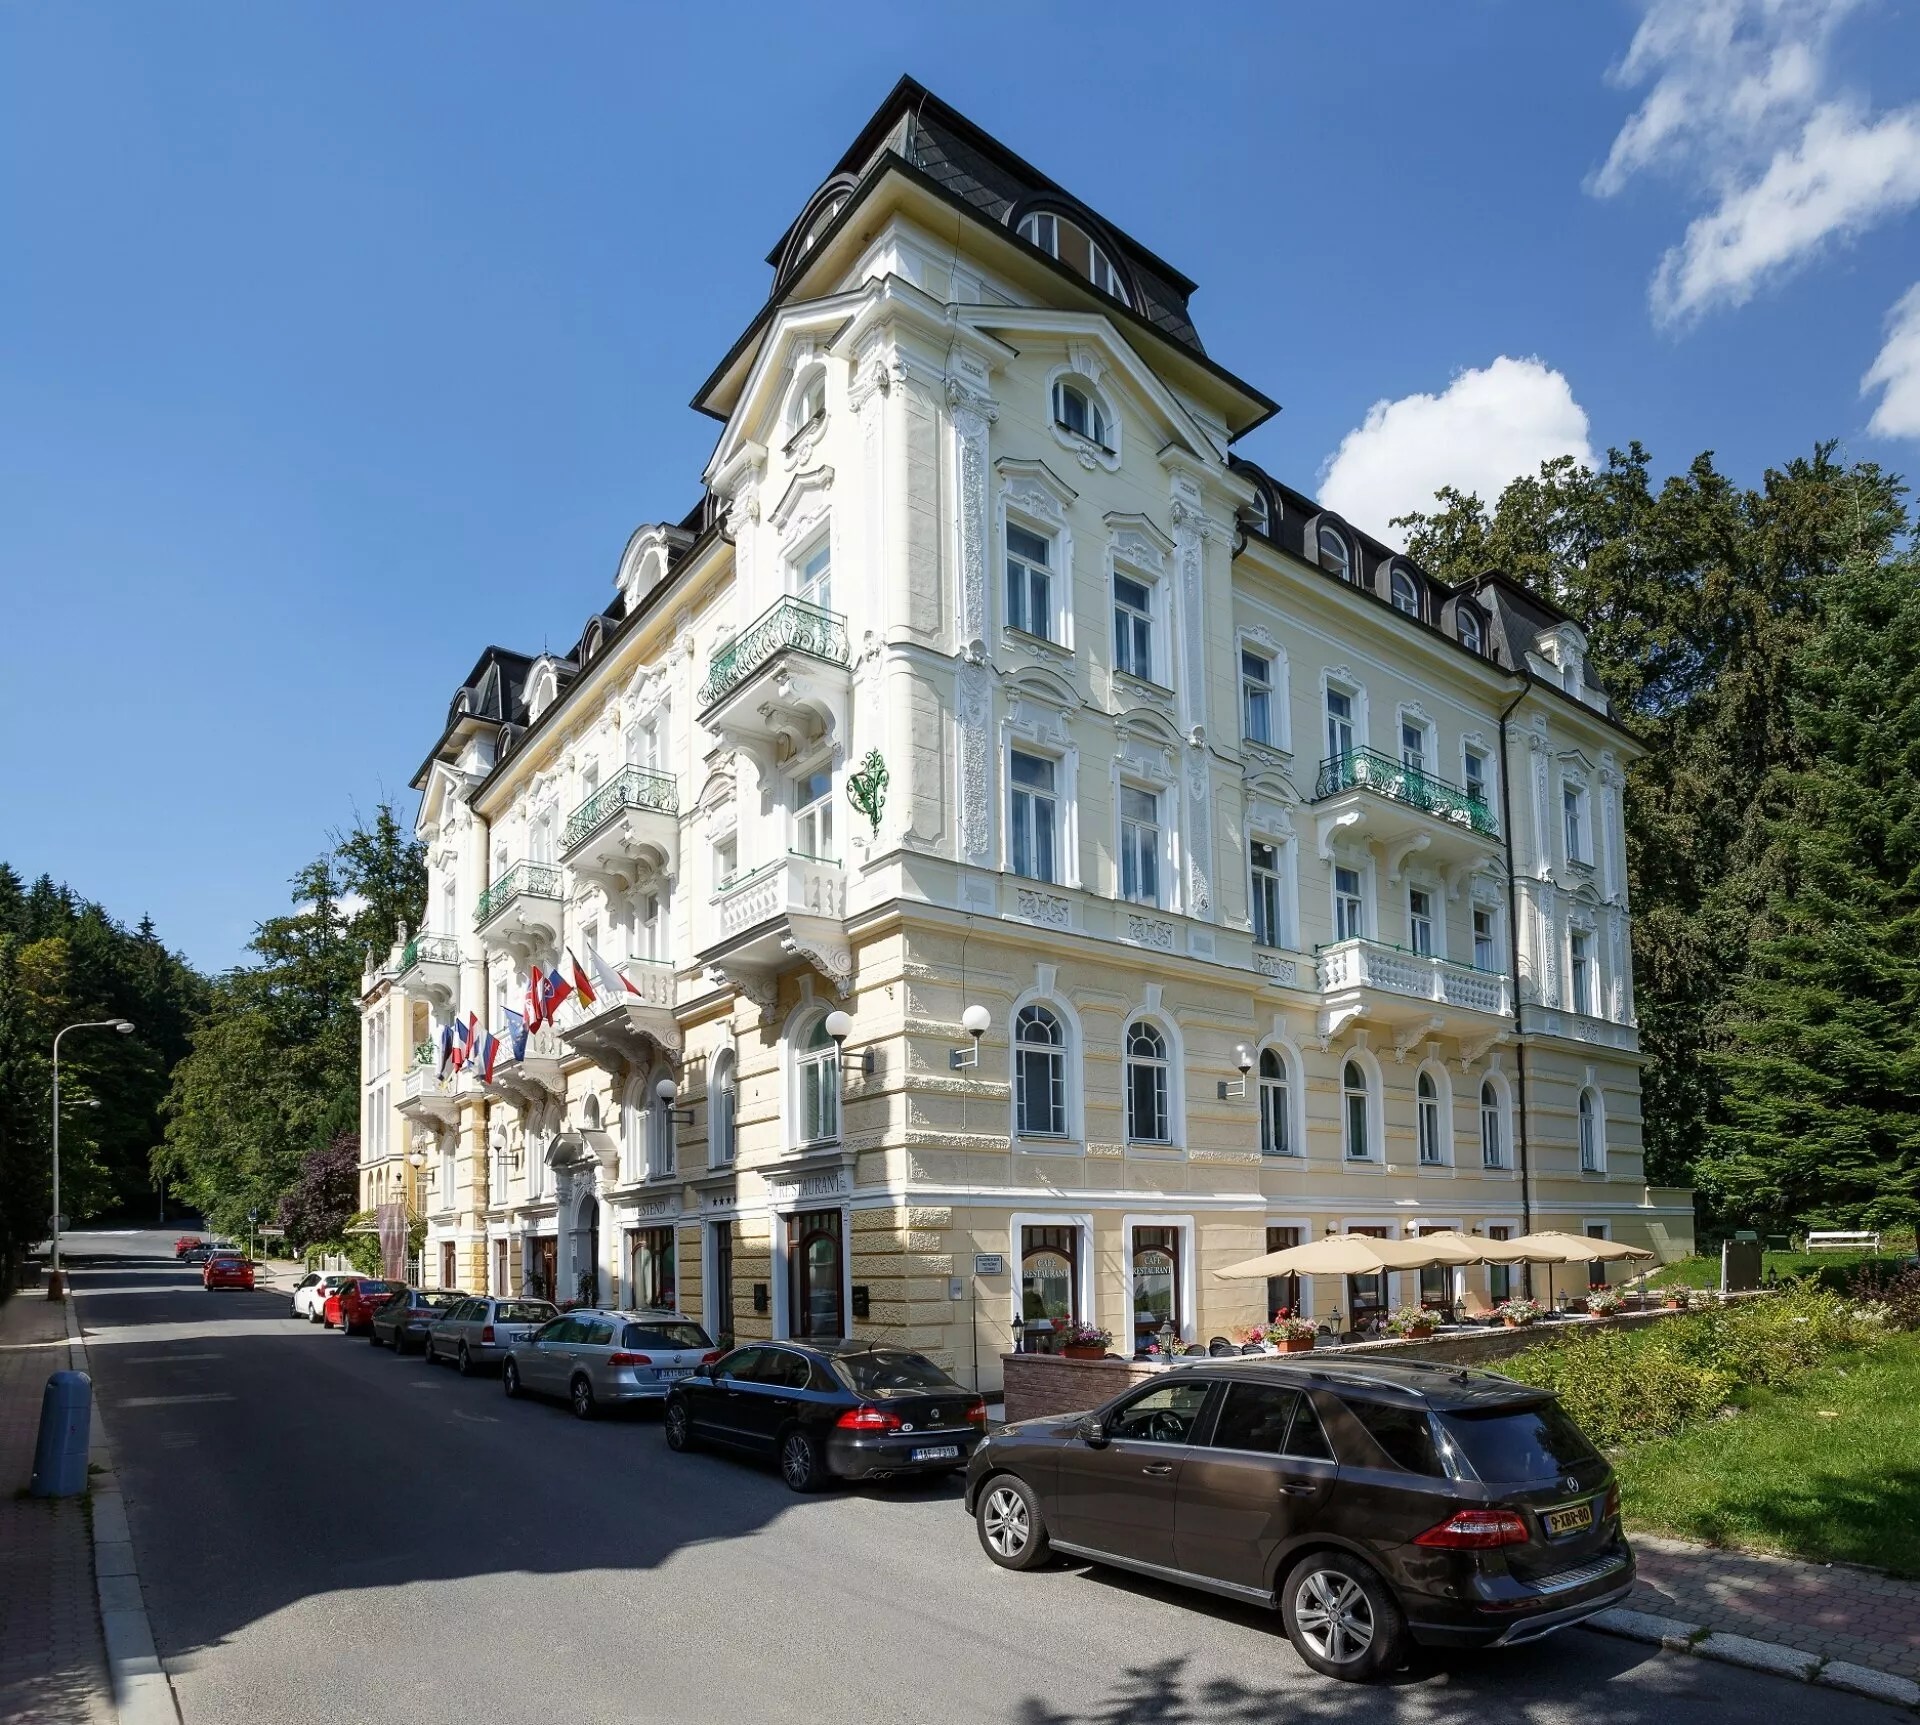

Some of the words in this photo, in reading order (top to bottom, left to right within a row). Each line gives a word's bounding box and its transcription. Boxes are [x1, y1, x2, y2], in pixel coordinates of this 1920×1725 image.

[778, 1174, 839, 1198] RESTAURANT
[631, 1201, 665, 1216] WESTEND
[1023, 1269, 1071, 1279] RESTAURANT
[1132, 1266, 1171, 1275] RESTAURANT
[1551, 1507, 1590, 1530] 9-XBR-80
